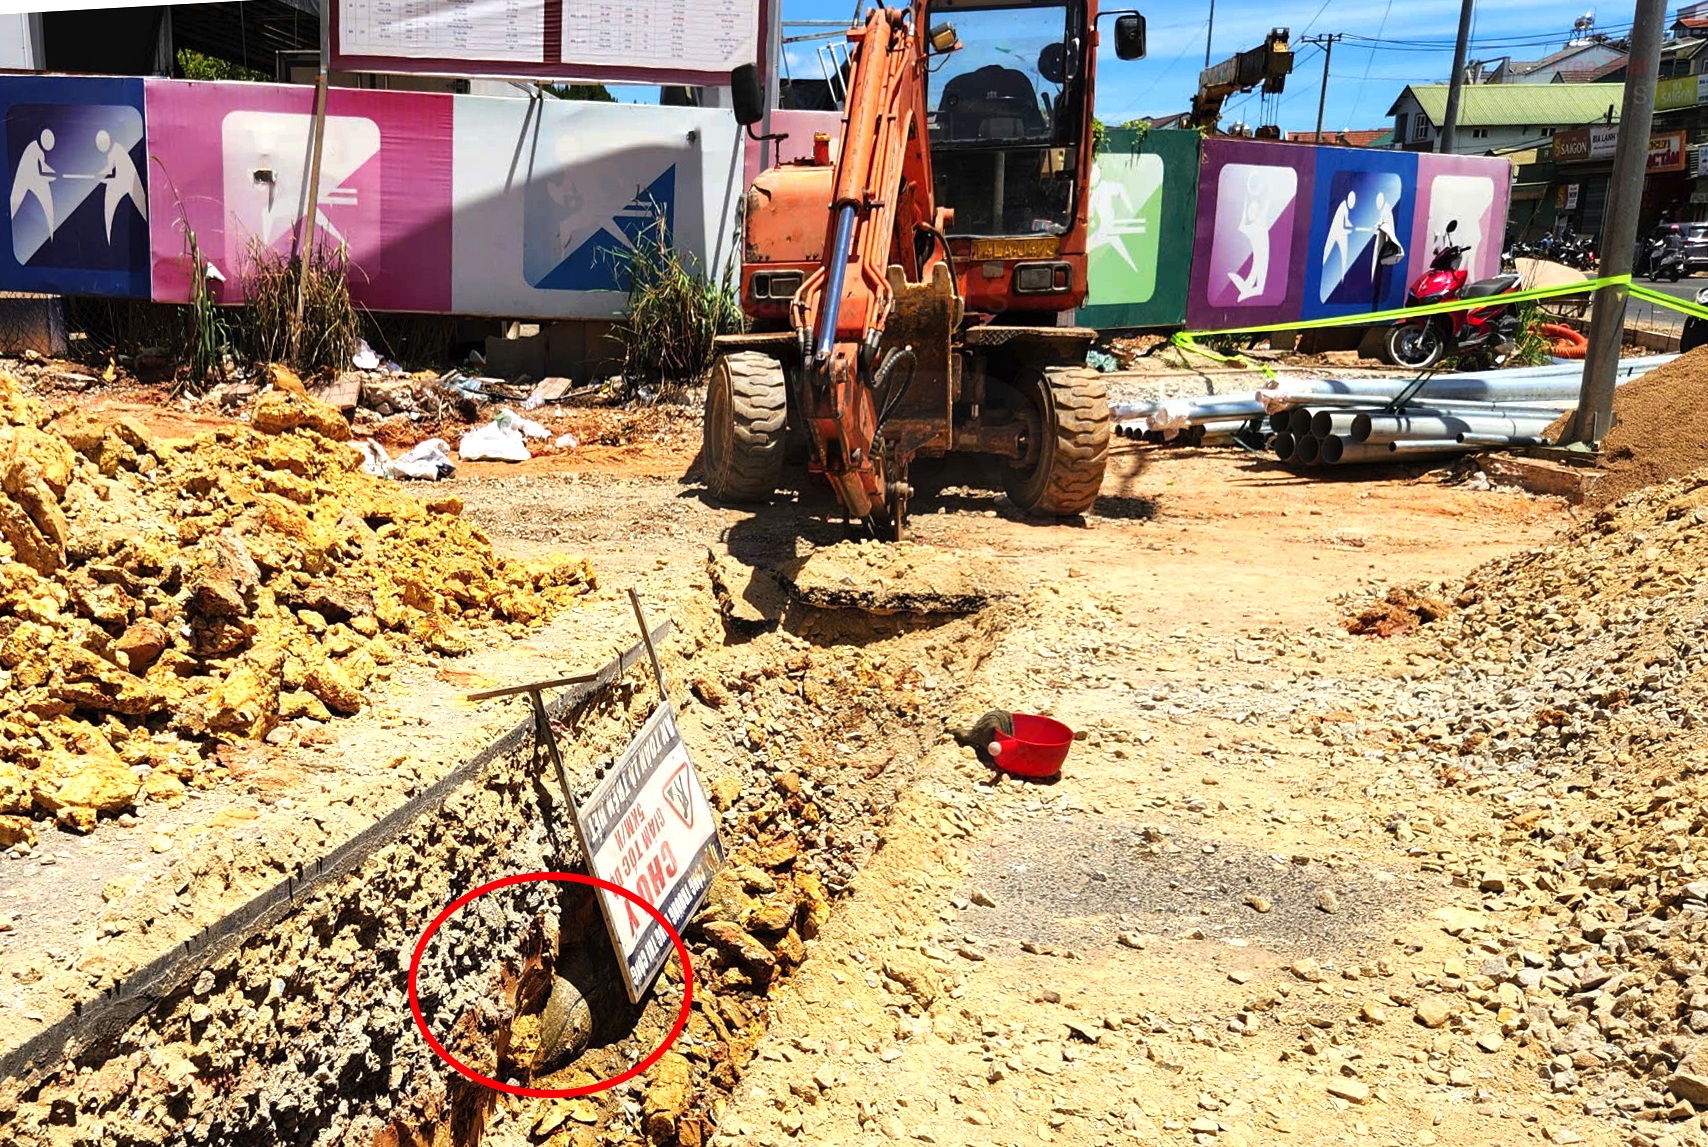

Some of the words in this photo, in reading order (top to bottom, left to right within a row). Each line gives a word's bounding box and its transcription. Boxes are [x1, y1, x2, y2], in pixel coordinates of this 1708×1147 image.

[1560, 142, 1588, 155] SAIGON
[658, 714, 675, 745] AN
[630, 949, 650, 986] CÔNG
